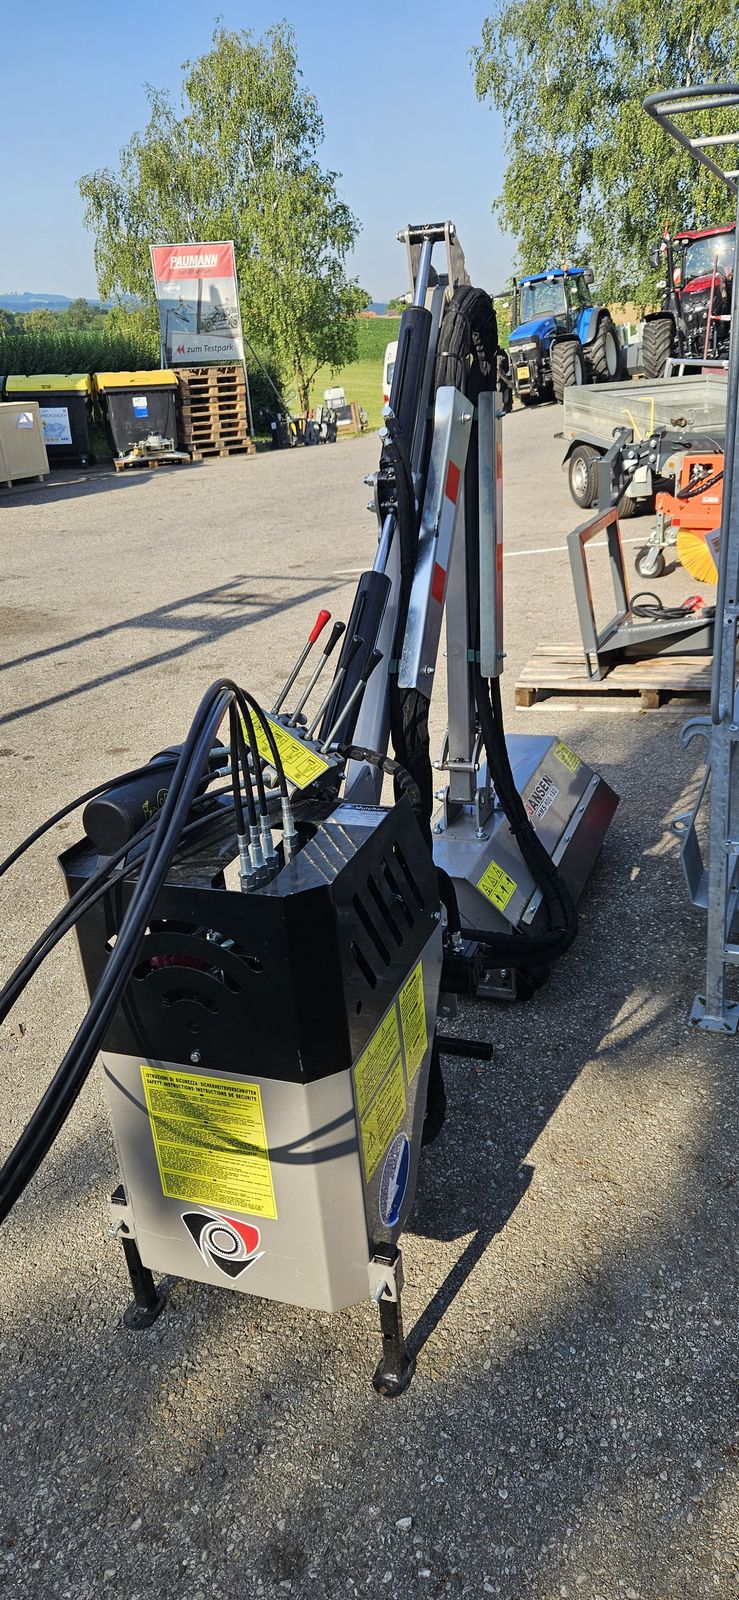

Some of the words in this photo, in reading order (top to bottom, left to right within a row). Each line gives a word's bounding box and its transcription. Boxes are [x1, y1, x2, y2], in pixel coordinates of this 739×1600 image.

[170, 254, 218, 269] PAUMANN
[204, 343, 234, 354] Testpark
[525, 774, 554, 816] JANSEN
[147, 1078, 162, 1087] SAFETY
[163, 1081, 194, 1092] INSTRUCTIONS
[196, 1086, 227, 1097] INSTRUCTIONS
[175, 1077, 198, 1086] SICUREZZA
[200, 1082, 257, 1095] SICHERHEITSVORSCHRIFTEN
